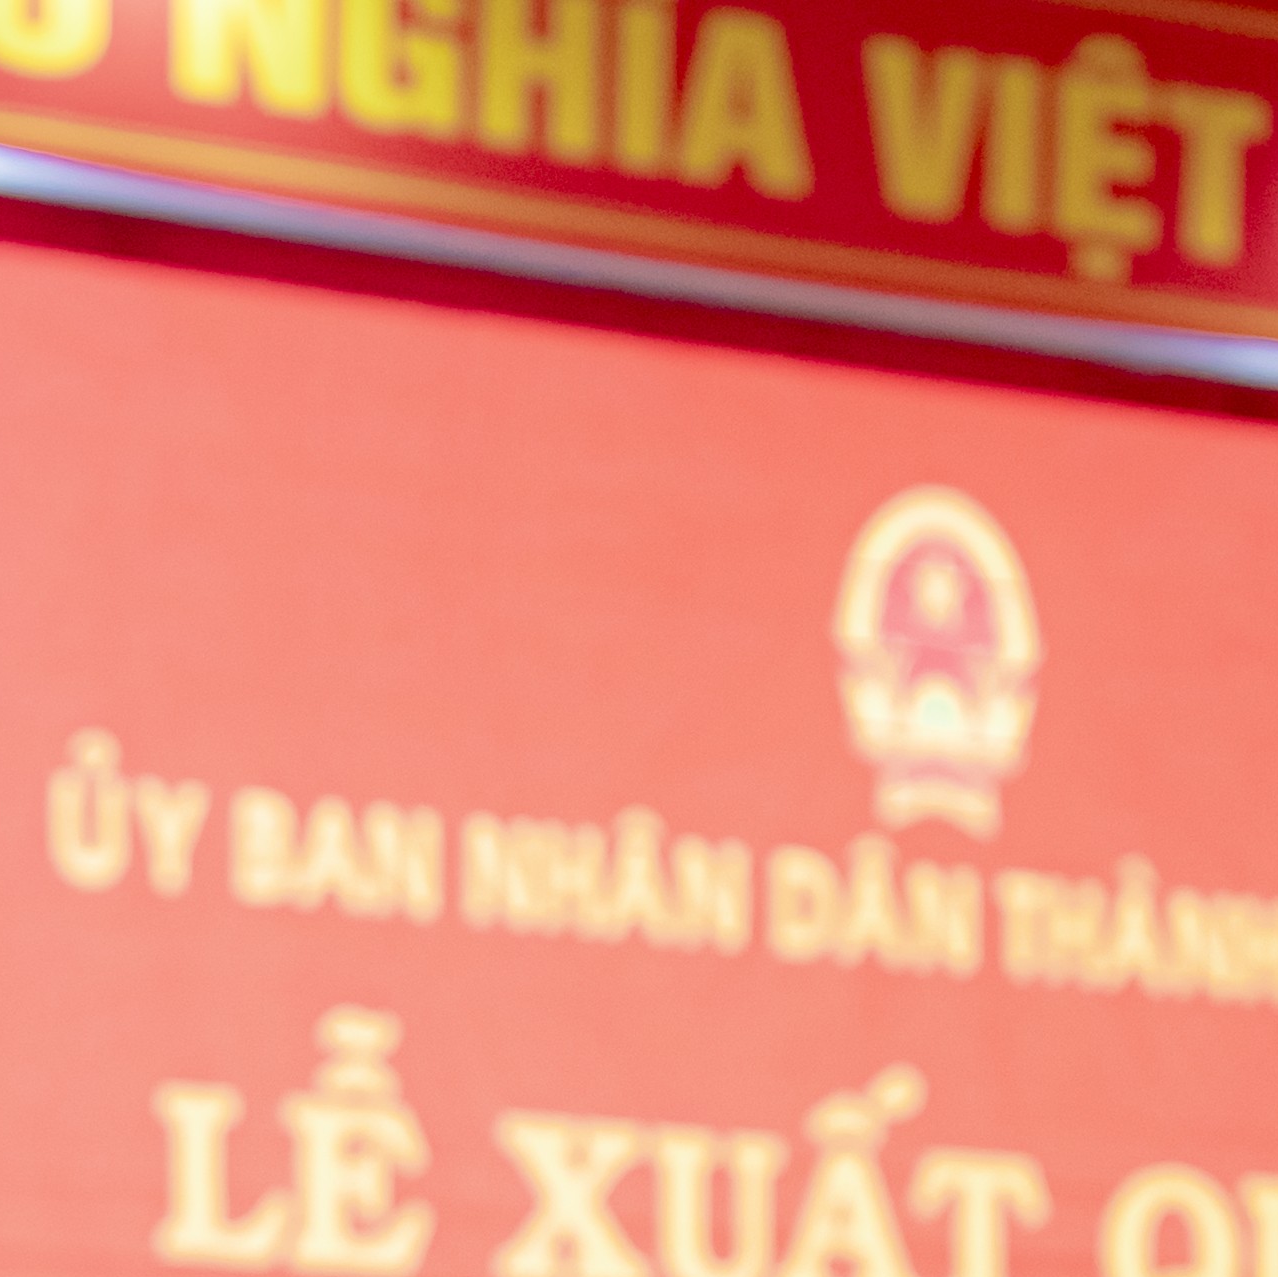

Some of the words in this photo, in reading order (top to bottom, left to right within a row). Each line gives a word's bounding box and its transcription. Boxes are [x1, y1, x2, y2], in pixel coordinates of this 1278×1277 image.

[865, 38, 1265, 277] VIỆT
[47, 731, 205, 894] ỦY
[233, 788, 440, 920] BAN
[462, 809, 747, 948] NHÂN
[769, 834, 979, 974] DÂN
[154, 1009, 431, 1276] LỄ
